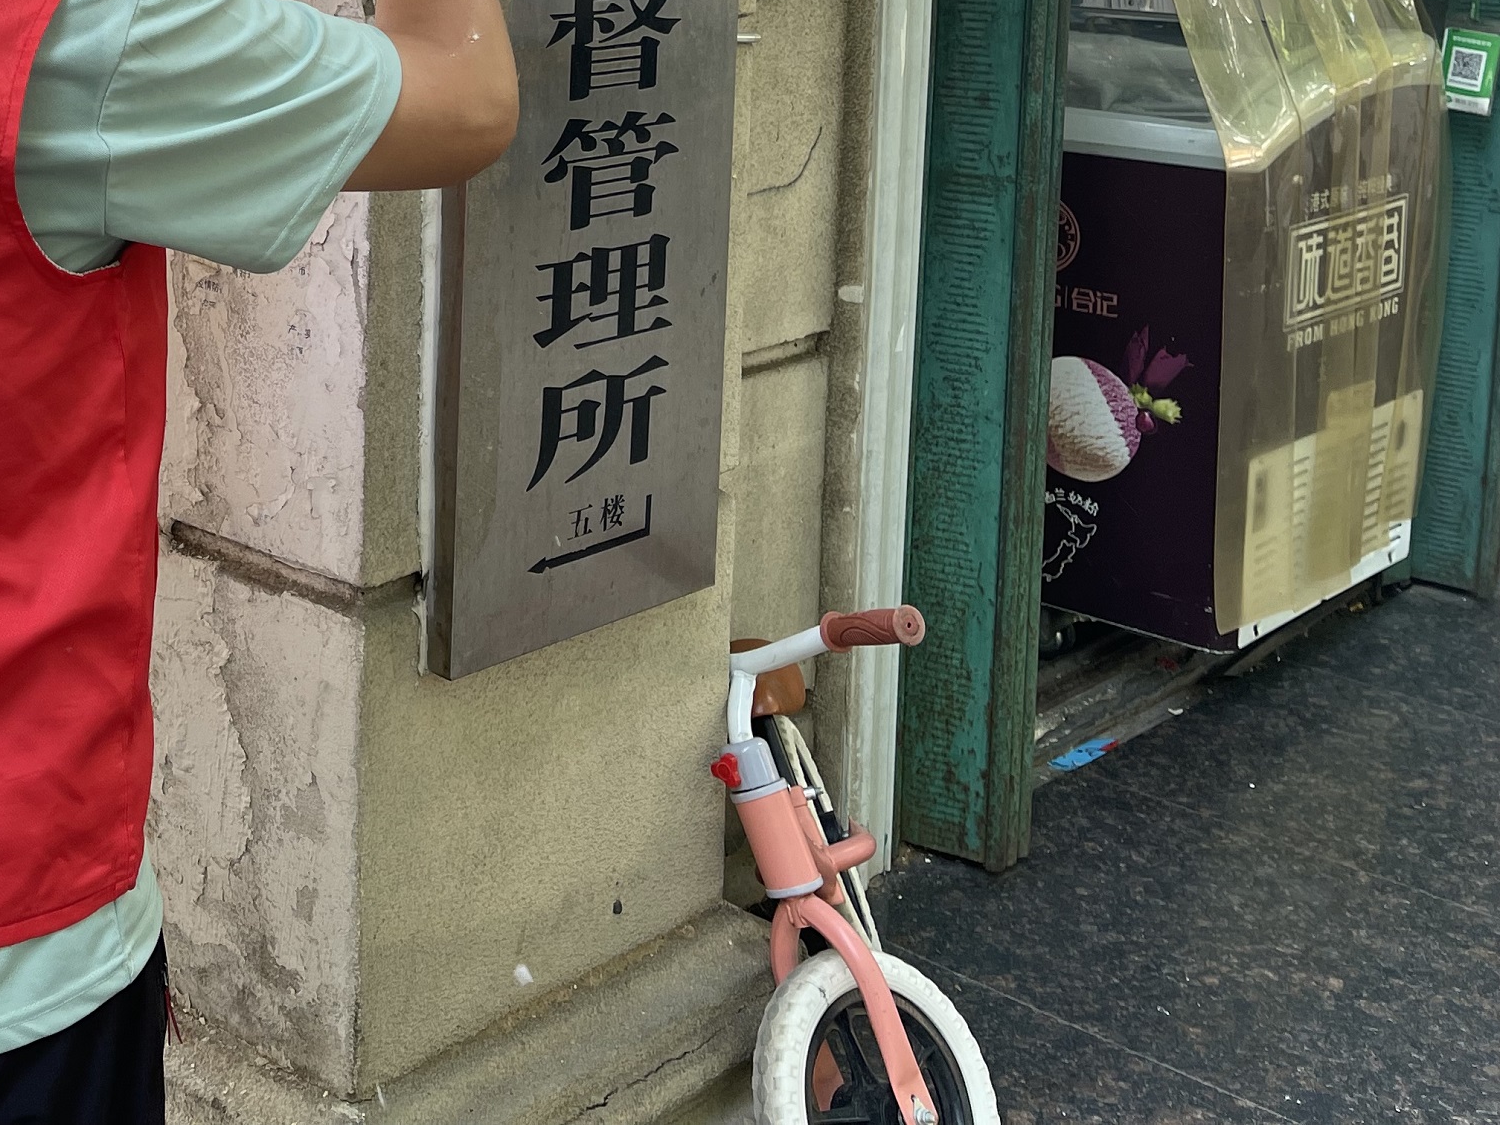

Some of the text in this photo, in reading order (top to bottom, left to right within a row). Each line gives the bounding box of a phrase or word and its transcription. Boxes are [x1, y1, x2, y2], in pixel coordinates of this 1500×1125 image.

[1286, 295, 1400, 353] FROM HONG KONG
[566, 494, 626, 542] 五楼
